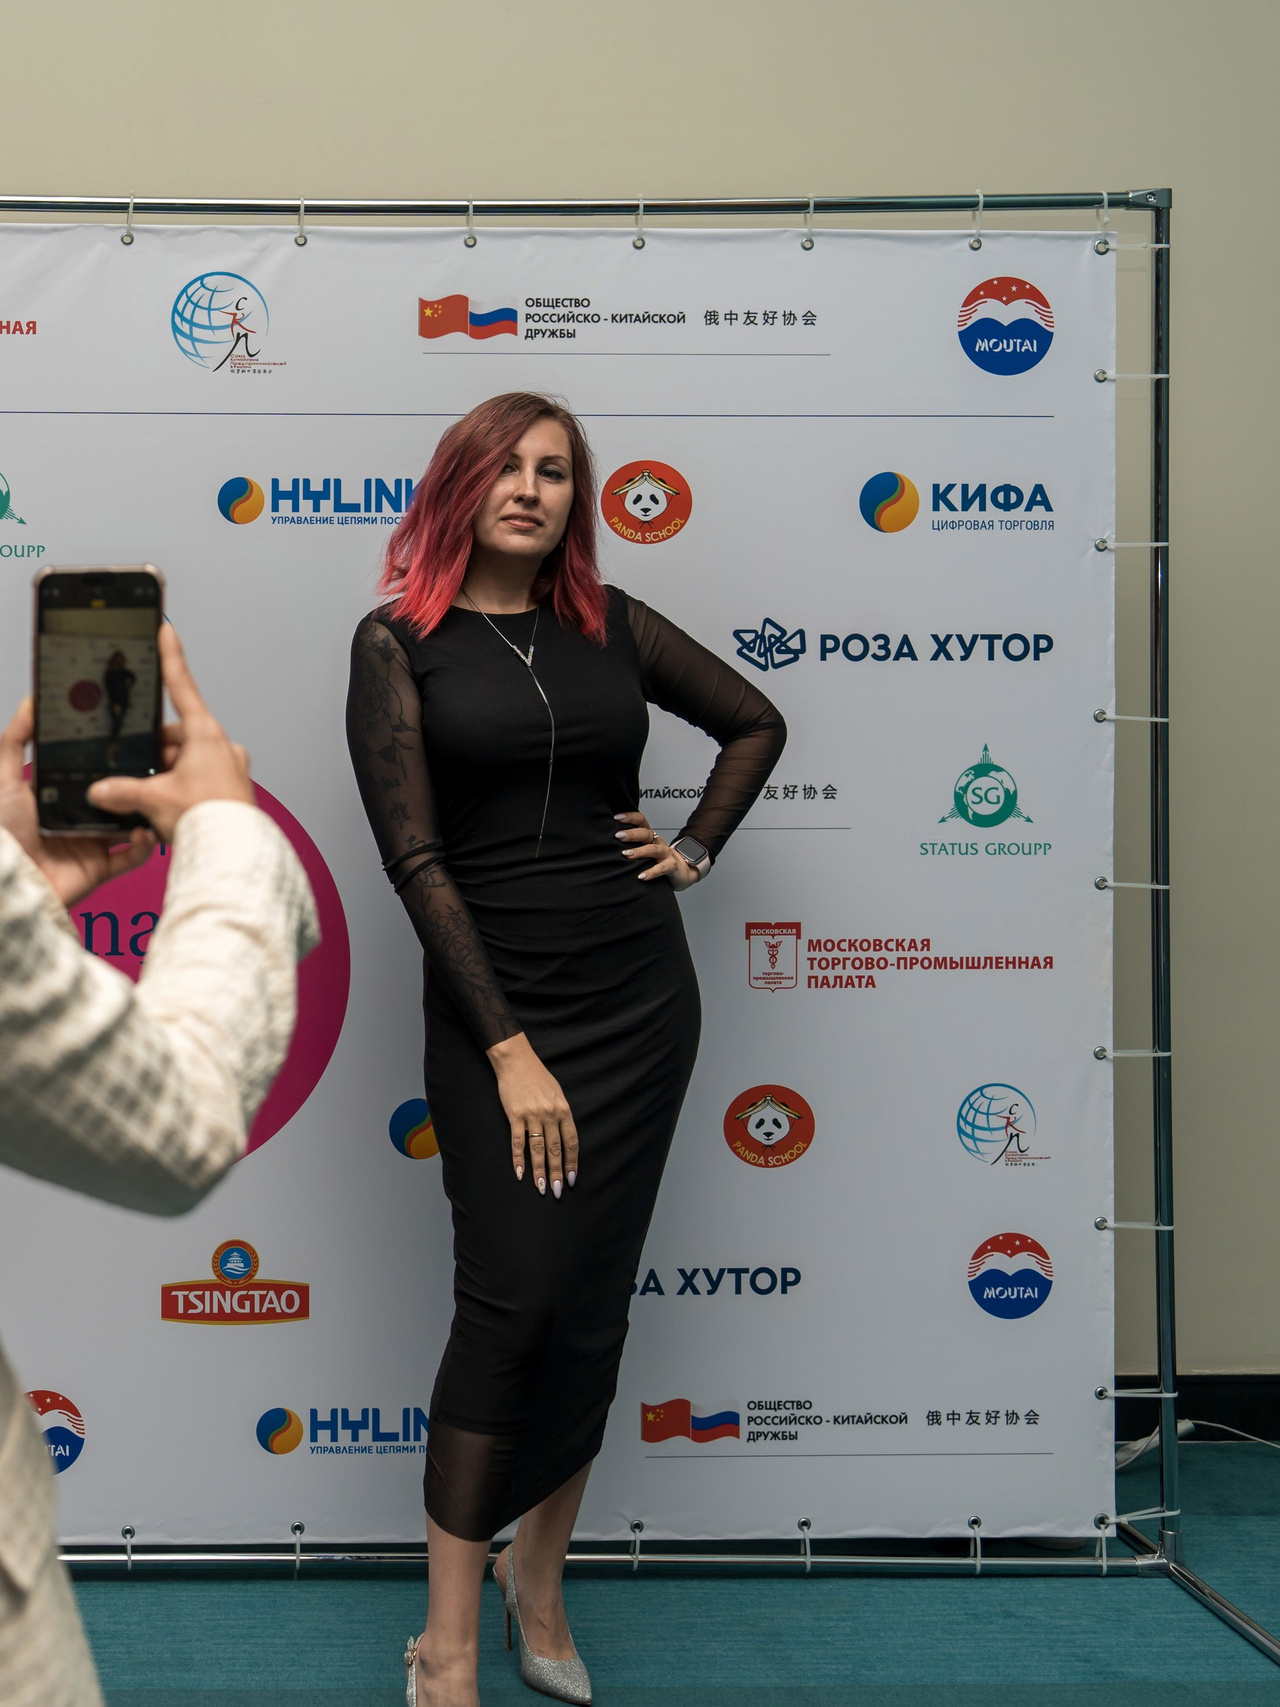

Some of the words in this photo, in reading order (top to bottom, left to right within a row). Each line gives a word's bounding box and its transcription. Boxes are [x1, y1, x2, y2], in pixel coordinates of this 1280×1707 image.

[525, 298, 591, 309] ОБЩЕСТВО
[525, 311, 601, 324] РОССИЙСКО
[611, 311, 686, 324] КИТАЙСКОЙ
[703, 309, 818, 326] 俄中友好协会
[524, 328, 576, 339] ДРУЖБЫ
[975, 337, 1038, 354] MOUTAI
[931, 483, 1054, 512] КИФА
[271, 516, 335, 525] УПРАВЛЕНИЕ
[337, 516, 378, 526] ЦЕПЯМИ
[931, 520, 995, 532] ЦИФРОВАЯ
[998, 520, 1055, 531] ТОРГОВЛЯ
[610, 517, 642, 542] PANDA
[645, 517, 685, 542] SCHOOL
[819, 633, 918, 662] РОЗА
[929, 633, 1054, 662] ХУТОР
[639, 786, 705, 799] ИТАЙСКОЙ
[763, 784, 838, 800] 友好协会
[970, 786, 1001, 805] SG
[920, 842, 979, 856] STATUS
[984, 842, 1052, 856] GROUPP
[807, 938, 931, 953] МОСКОВСКАЯ
[807, 956, 1054, 971] ТОРГОВО-ПРОМЫШЛЕННАЯ
[807, 975, 877, 989] ПАЛАТА
[732, 1141, 765, 1165] PANDA
[768, 1141, 808, 1166] SCHOOL
[675, 1267, 802, 1297] ХУТОР
[983, 1286, 1039, 1300] MOUTAI
[170, 1289, 301, 1314] TSINGTAO
[747, 1400, 812, 1412] ОБЩЕСТВО
[310, 1407, 429, 1443] HYLIN
[747, 1413, 823, 1426] РОССИЙСКО
[833, 1412, 908, 1425] КИТАЙСКОЙ
[925, 1409, 1040, 1426] 俄中友好协会
[746, 1431, 798, 1442] ДРУЖБЫ
[310, 1446, 374, 1455] УПРАВЛЕНИЕ
[376, 1445, 417, 1455] ЦЕПЯМИ
